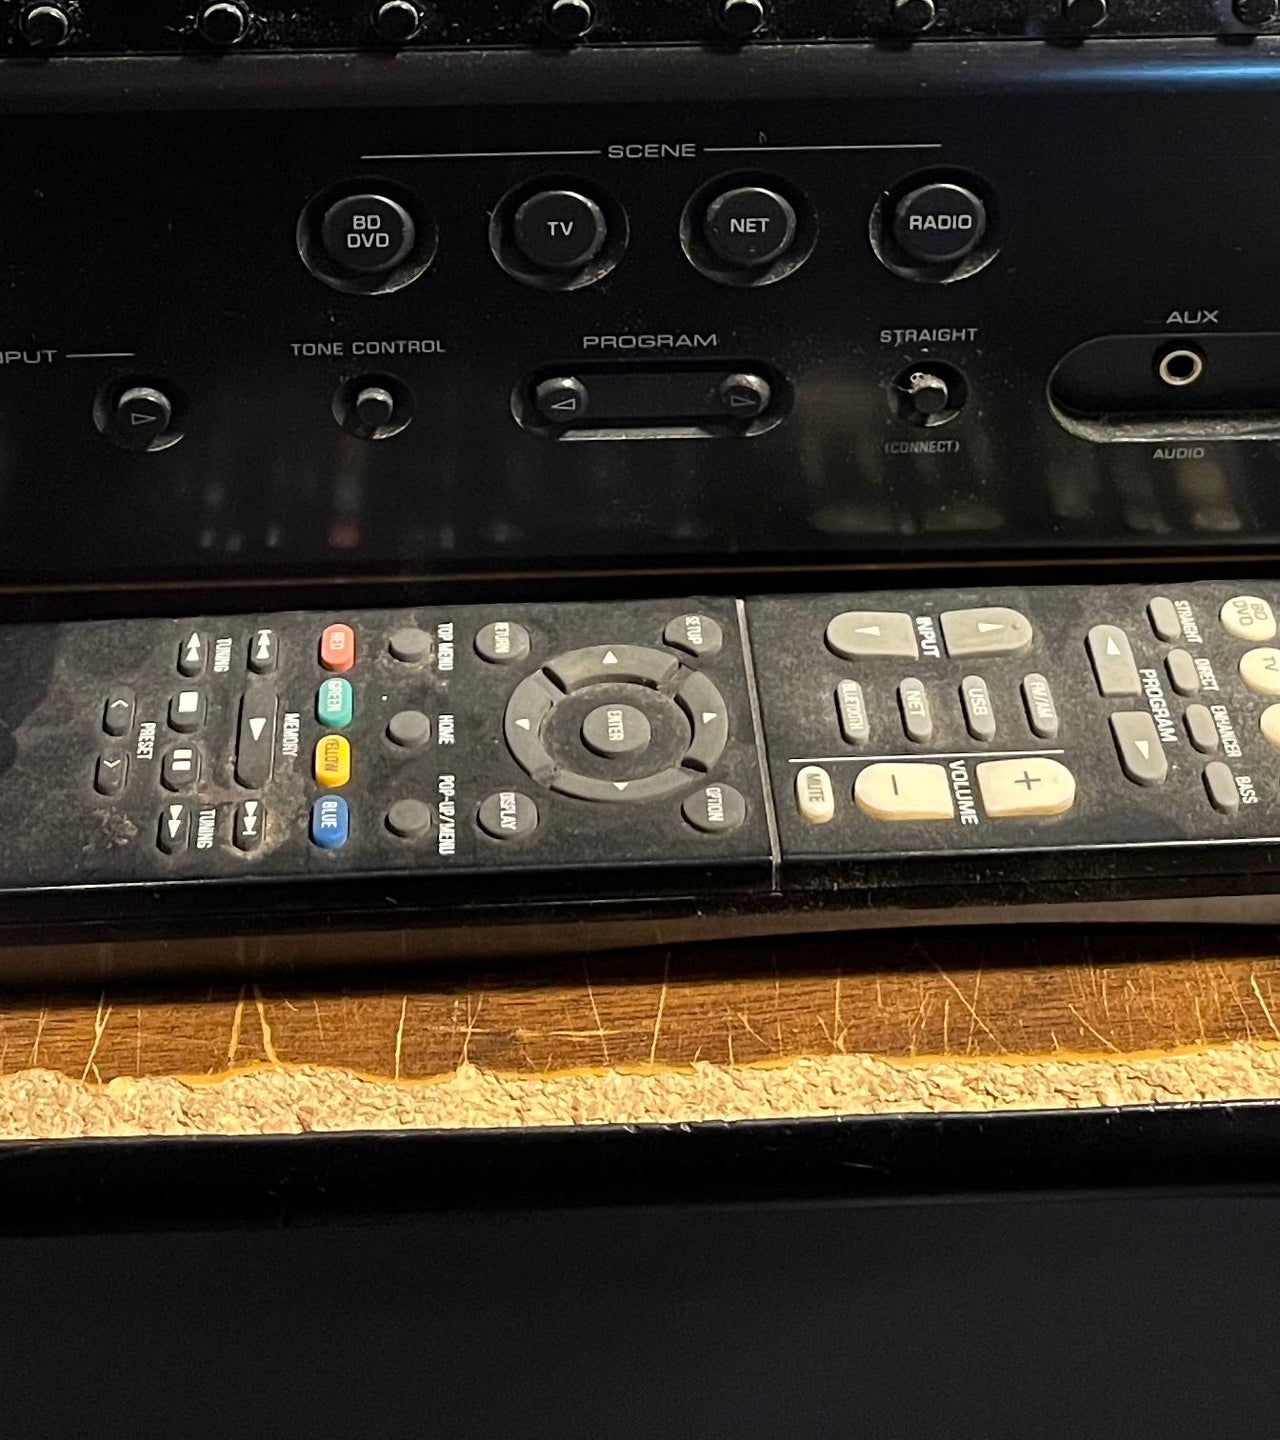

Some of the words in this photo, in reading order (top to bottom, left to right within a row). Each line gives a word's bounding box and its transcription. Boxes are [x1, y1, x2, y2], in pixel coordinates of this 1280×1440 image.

[607, 143, 697, 158] SCENE
[352, 215, 381, 230] BD
[546, 221, 575, 238] TV
[730, 217, 770, 234] NET
[908, 214, 973, 232] RADIO
[347, 232, 390, 249] DVD
[1165, 309, 1220, 325] AUX
[290, 342, 344, 357] TONE
[351, 340, 447, 356] CONTROL
[582, 334, 719, 349] PROGRAM
[879, 328, 978, 344] STRAIGHT
[1152, 447, 1206, 460] AUDIO
[437, 621, 454, 642] TOP
[685, 615, 703, 646] SETUP
[1173, 599, 1203, 644] STRAIGHT
[329, 630, 345, 651] RED
[916, 616, 940, 659] INPUT
[214, 637, 233, 673] TUNING
[437, 643, 454, 672] MENU
[1262, 657, 1279, 673] TV
[1194, 657, 1220, 692] DIRECT
[325, 679, 344, 713] GREEN
[906, 690, 926, 718] NET
[969, 688, 988, 717] USB
[1139, 668, 1178, 743] PROGRAM
[136, 721, 157, 760] PRESET
[282, 713, 300, 758] MEMORY
[437, 714, 455, 746] HOME
[607, 709, 625, 742] ENTER
[1210, 704, 1243, 758] ENHANCER
[323, 737, 340, 773] YELLOW
[805, 772, 826, 804] MUTE
[948, 759, 979, 826] VOLUME
[1234, 774, 1259, 805] BASS
[320, 800, 339, 829] BLUE
[499, 791, 517, 831] DISPLAY
[196, 807, 217, 850] TUNING
